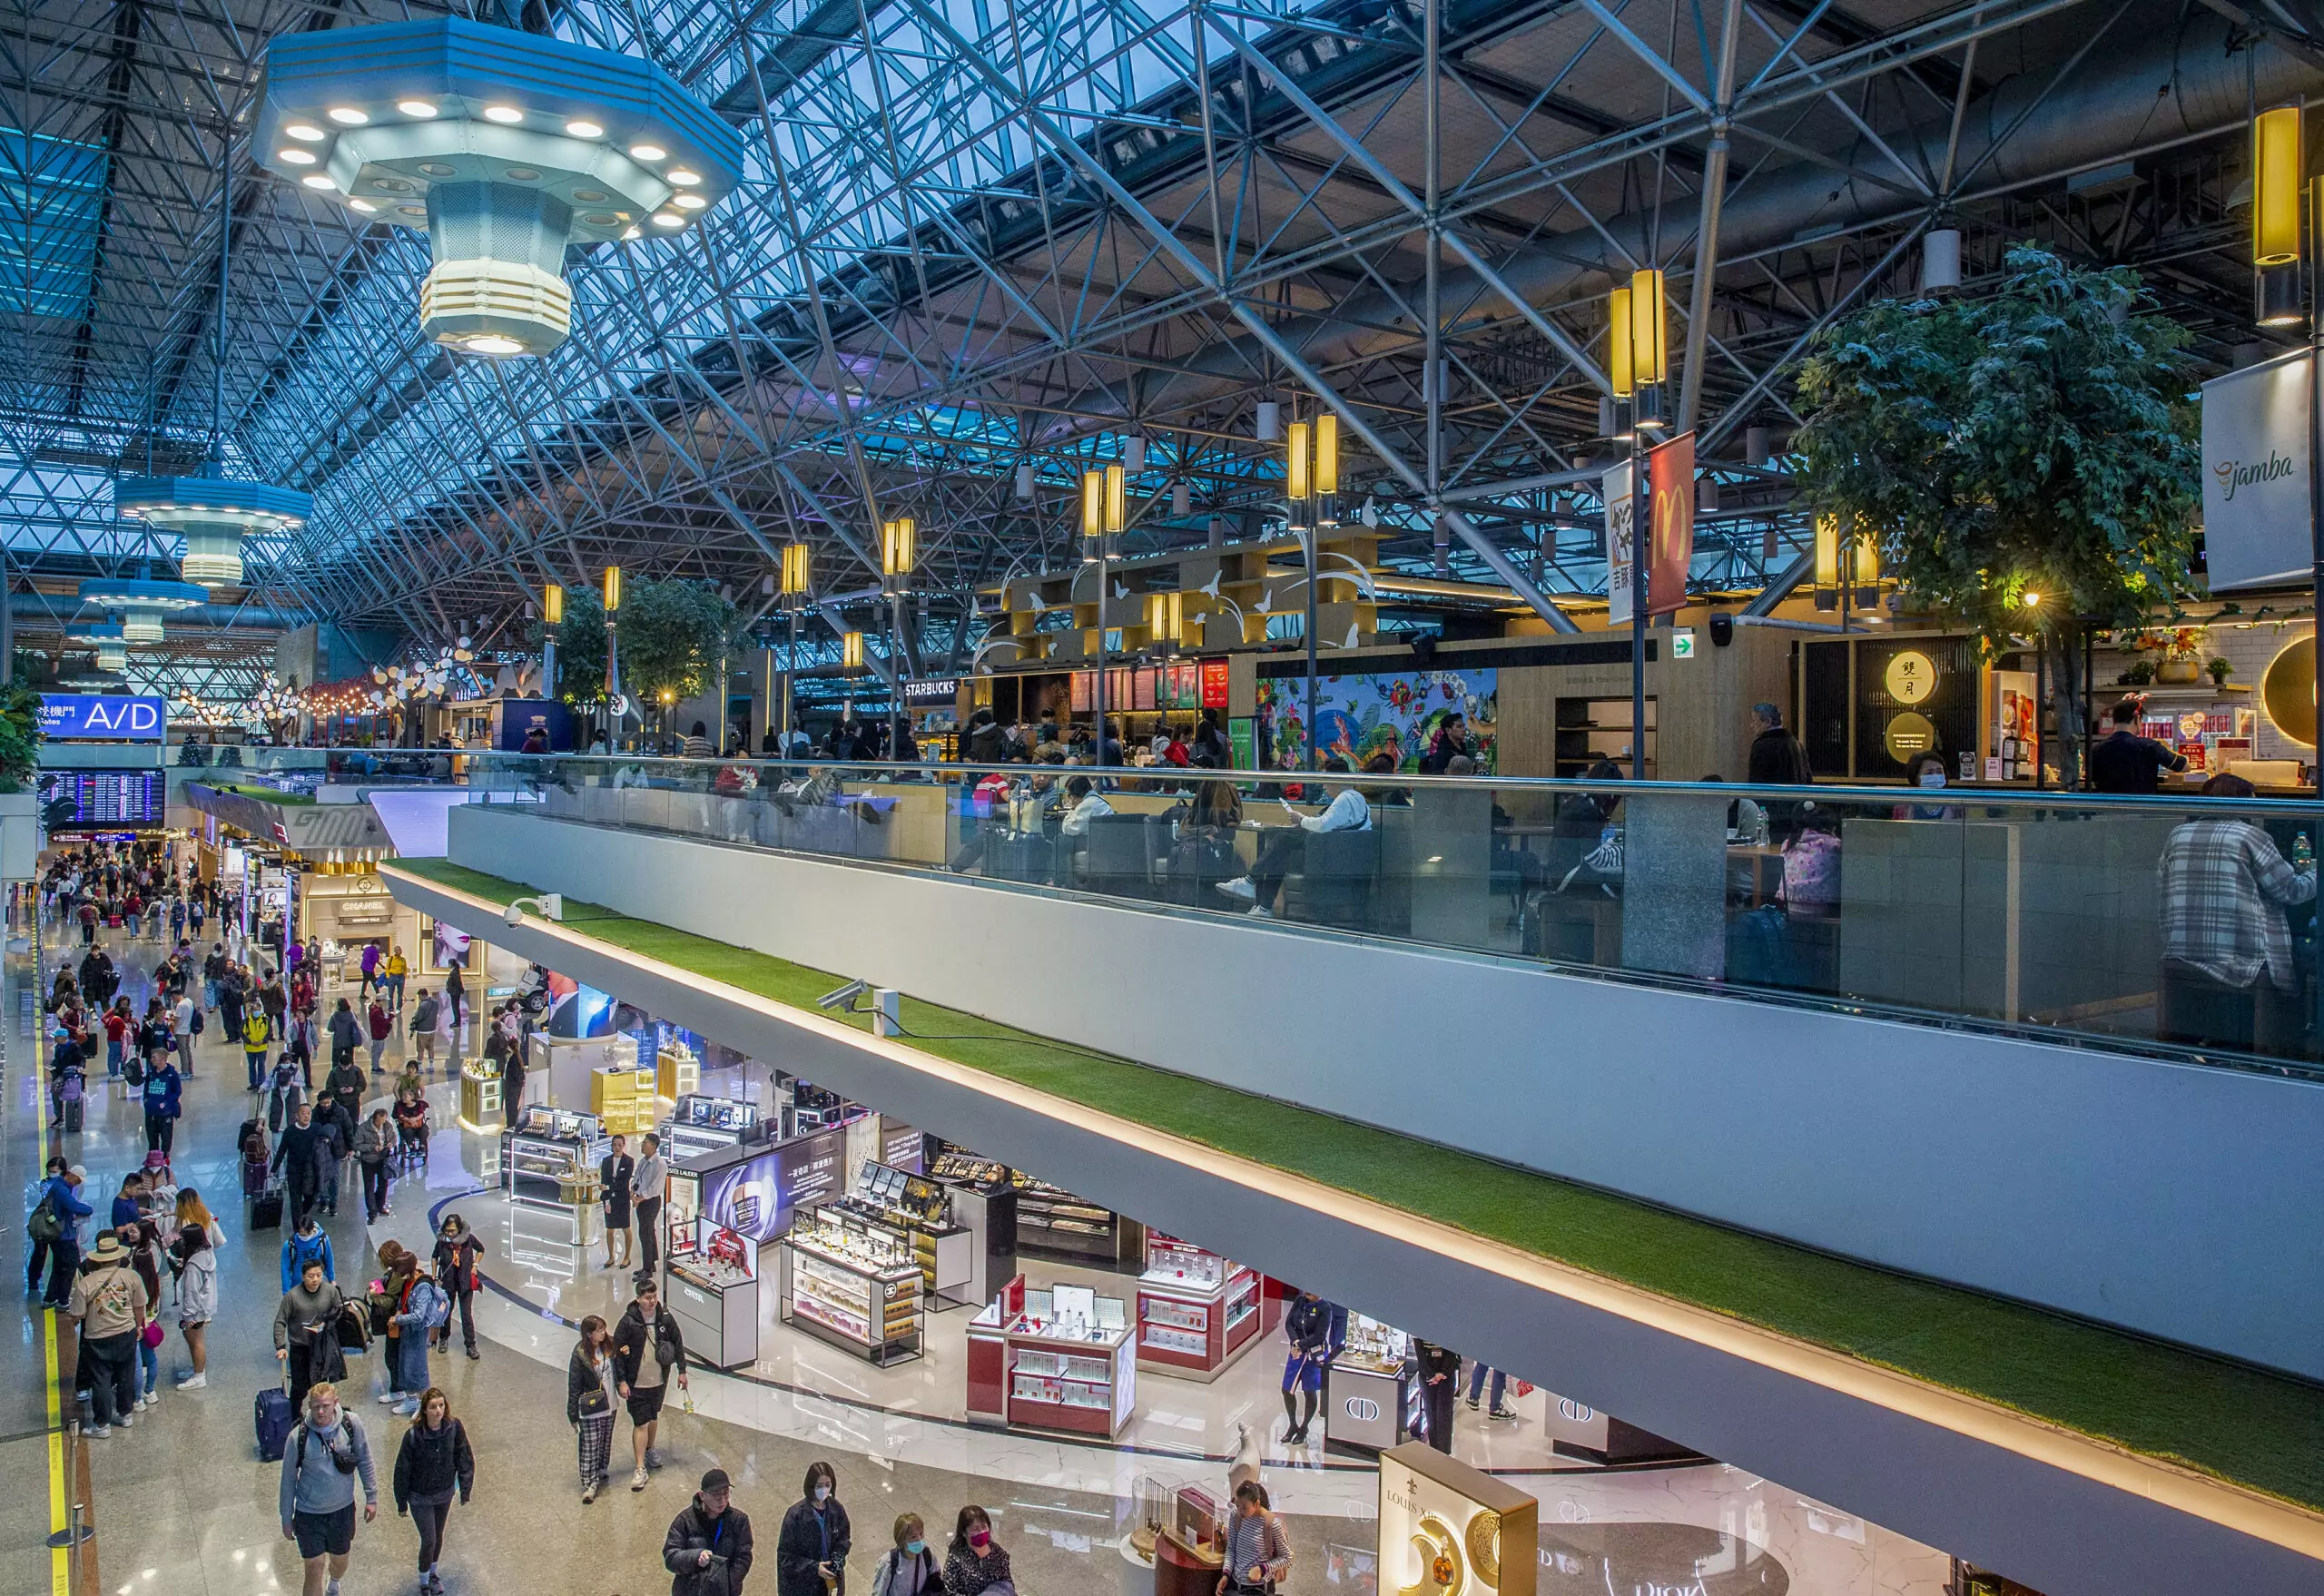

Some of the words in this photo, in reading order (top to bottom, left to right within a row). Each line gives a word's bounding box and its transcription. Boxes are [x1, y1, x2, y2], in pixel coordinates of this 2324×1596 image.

[2224, 449, 2294, 501] jamba
[905, 681, 955, 696] STARBUCKS
[1902, 661, 1915, 695] 雙月
[84, 702, 157, 730] A/D
[342, 901, 386, 911] CHANEL
[679, 1169, 698, 1178] LAUDER
[1387, 1490, 1417, 1513] LOUIS
